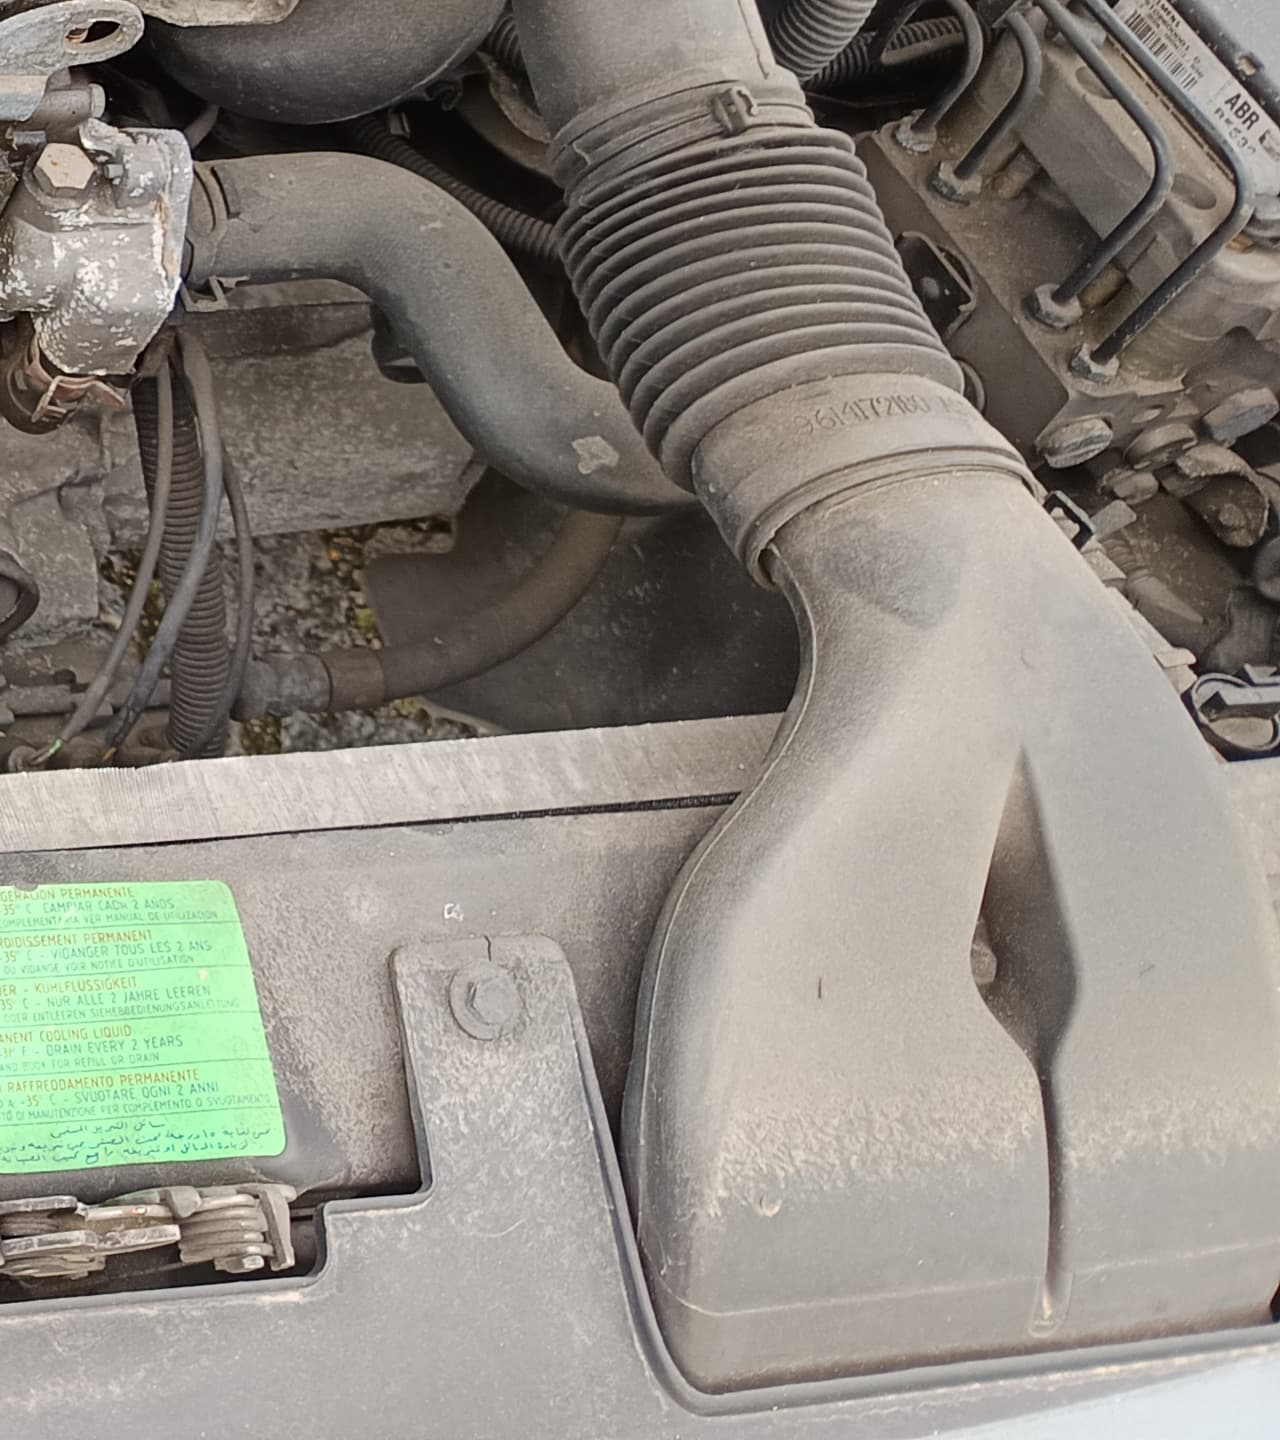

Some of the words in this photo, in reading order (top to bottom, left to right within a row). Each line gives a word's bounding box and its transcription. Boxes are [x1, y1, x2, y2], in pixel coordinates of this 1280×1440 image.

[61, 886, 134, 900] PERMANENTE
[83, 930, 153, 944] PERMANENT
[115, 943, 145, 955] TOUS
[177, 942, 183, 951] 2
[76, 993, 109, 1005] ALLE
[93, 1025, 133, 1038] LIQUID
[87, 1040, 126, 1053] EVERY
[131, 1039, 139, 1050] 2
[143, 1035, 184, 1049] YEARS
[119, 1069, 200, 1086] PERMANENTE
[176, 1085, 184, 1096] 2
